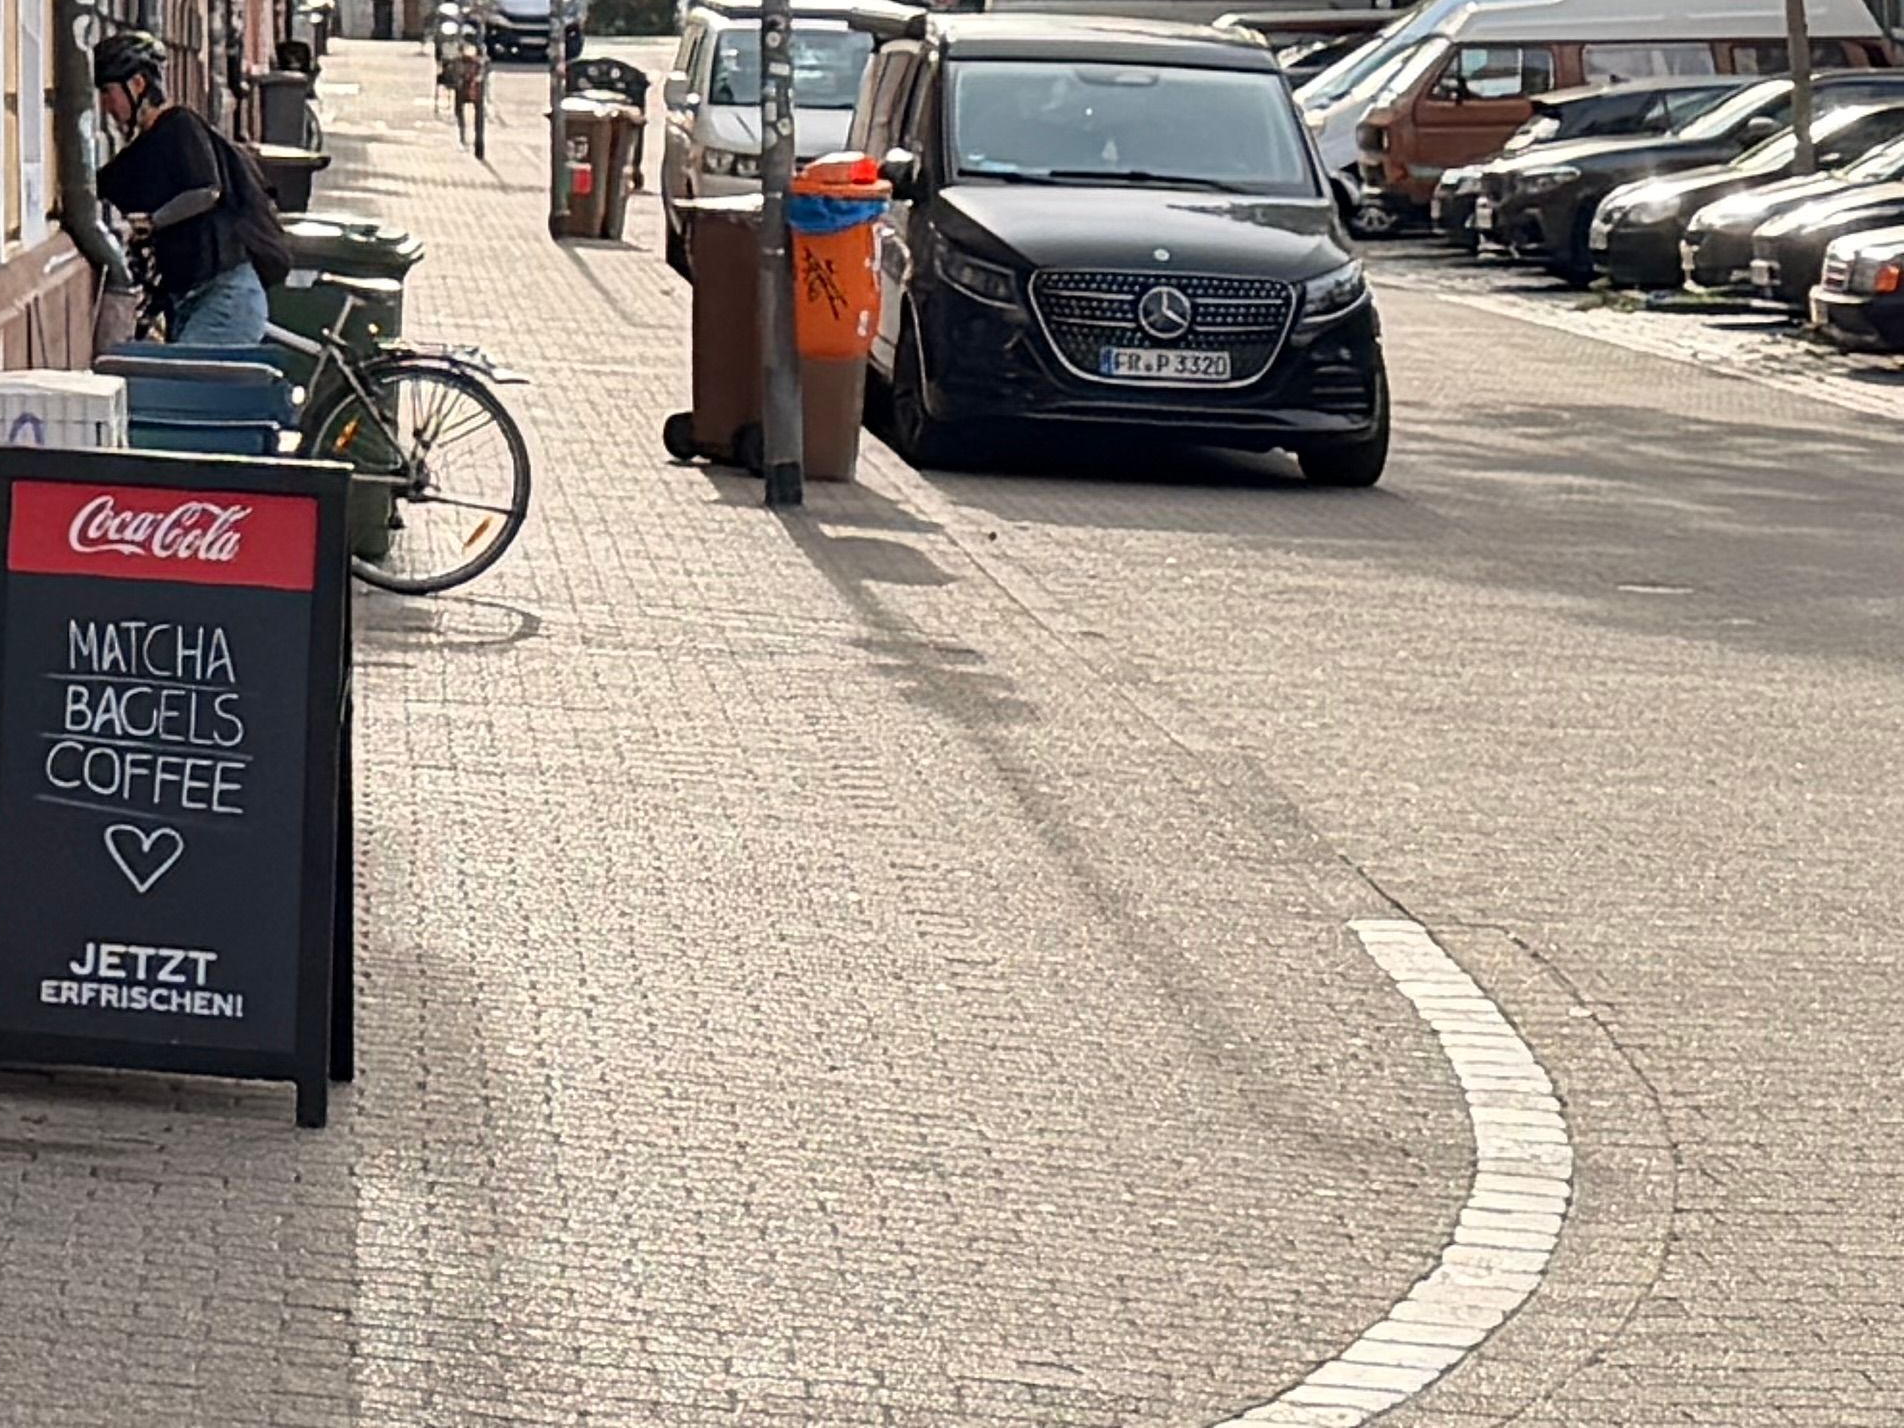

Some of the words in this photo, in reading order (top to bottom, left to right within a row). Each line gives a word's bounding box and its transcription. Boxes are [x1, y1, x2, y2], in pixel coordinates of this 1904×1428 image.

[69, 495, 253, 562] Coca-Cola
[68, 619, 236, 684] MATCHA
[64, 686, 244, 747] BAGELS
[46, 742, 245, 815] COFFEE
[69, 942, 217, 987] JETZT
[39, 980, 244, 1019] ERFRISCHEN!
